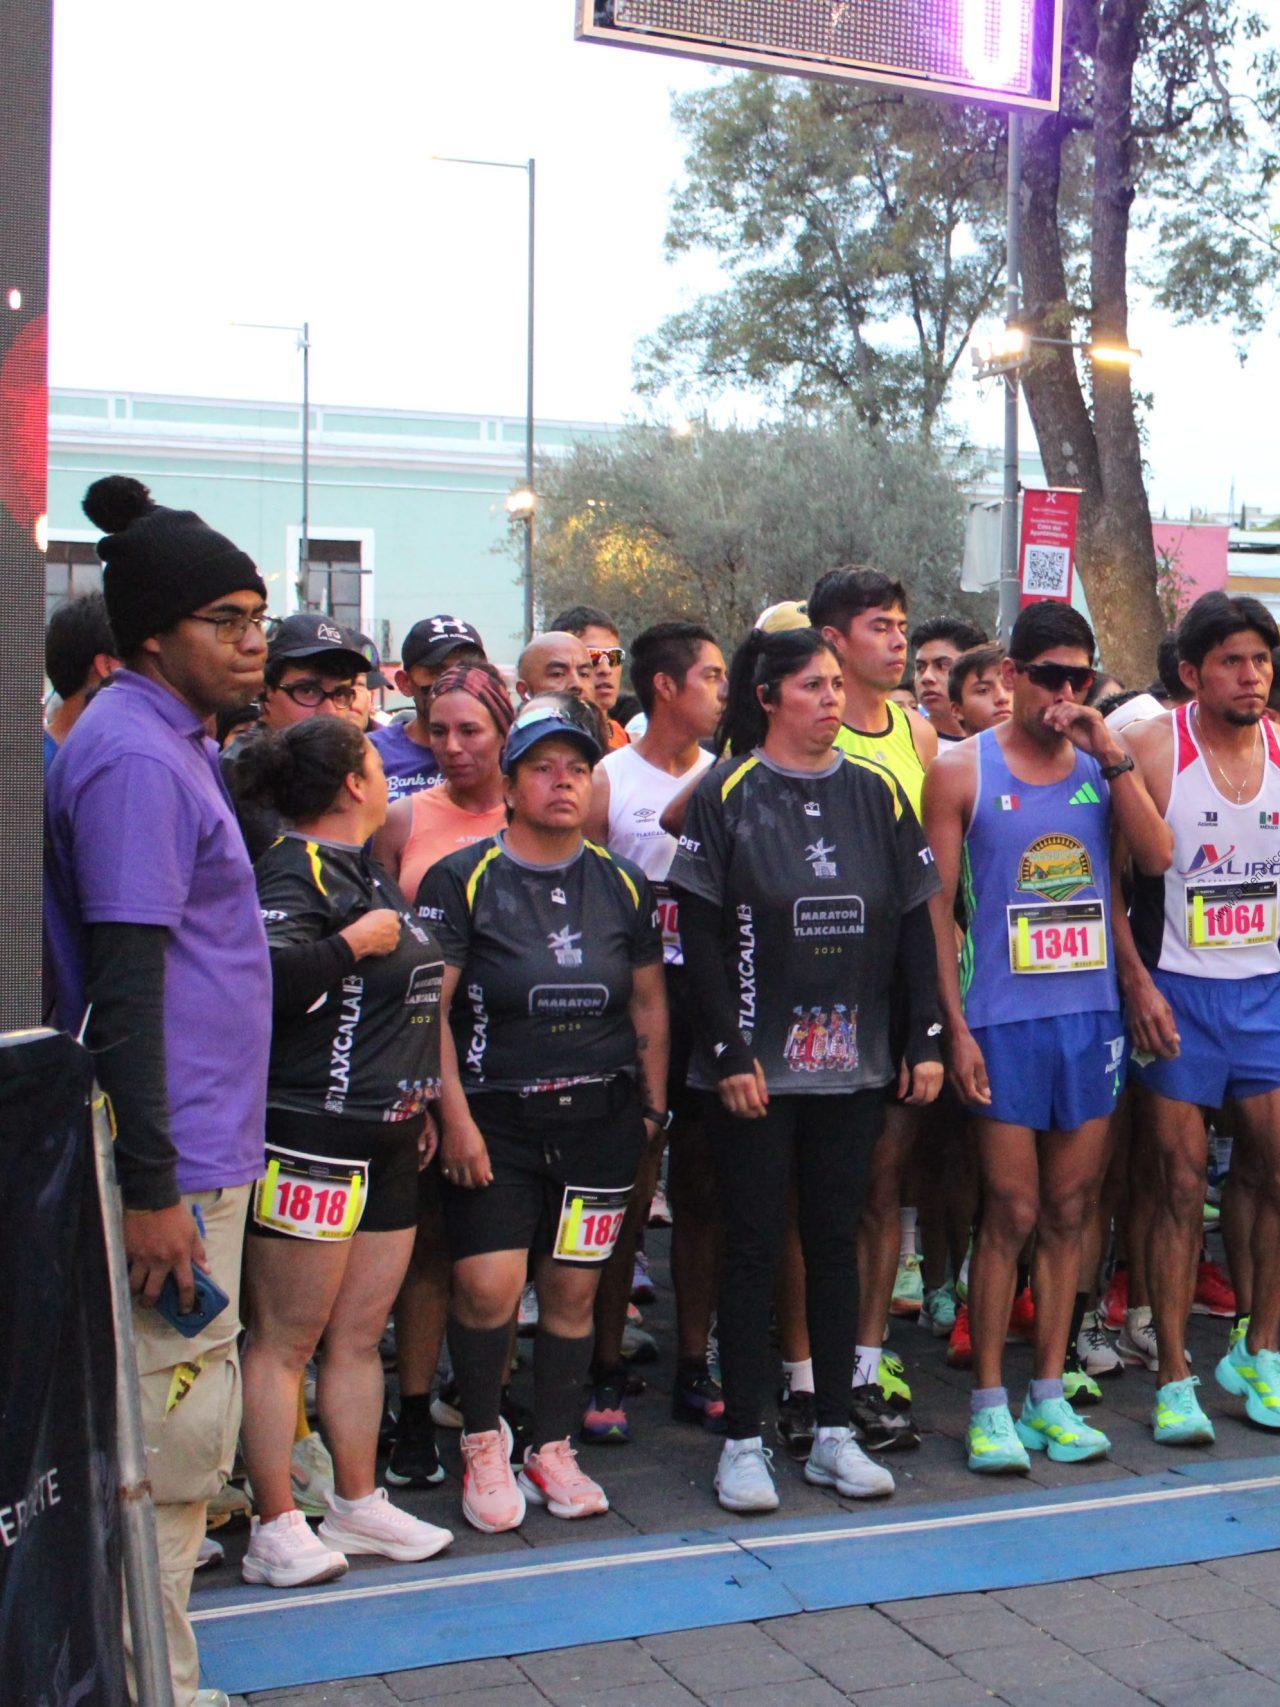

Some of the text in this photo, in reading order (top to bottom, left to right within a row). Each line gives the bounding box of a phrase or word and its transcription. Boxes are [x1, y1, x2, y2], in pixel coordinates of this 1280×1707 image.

[388, 773, 426, 791] Bank
[418, 906, 445, 920] IDET
[800, 910, 858, 921] MARATON
[1203, 903, 1265, 936] 1064
[1030, 926, 1089, 961] 1341
[738, 923, 756, 1029] TLAXCALA
[277, 1181, 348, 1226] 1818
